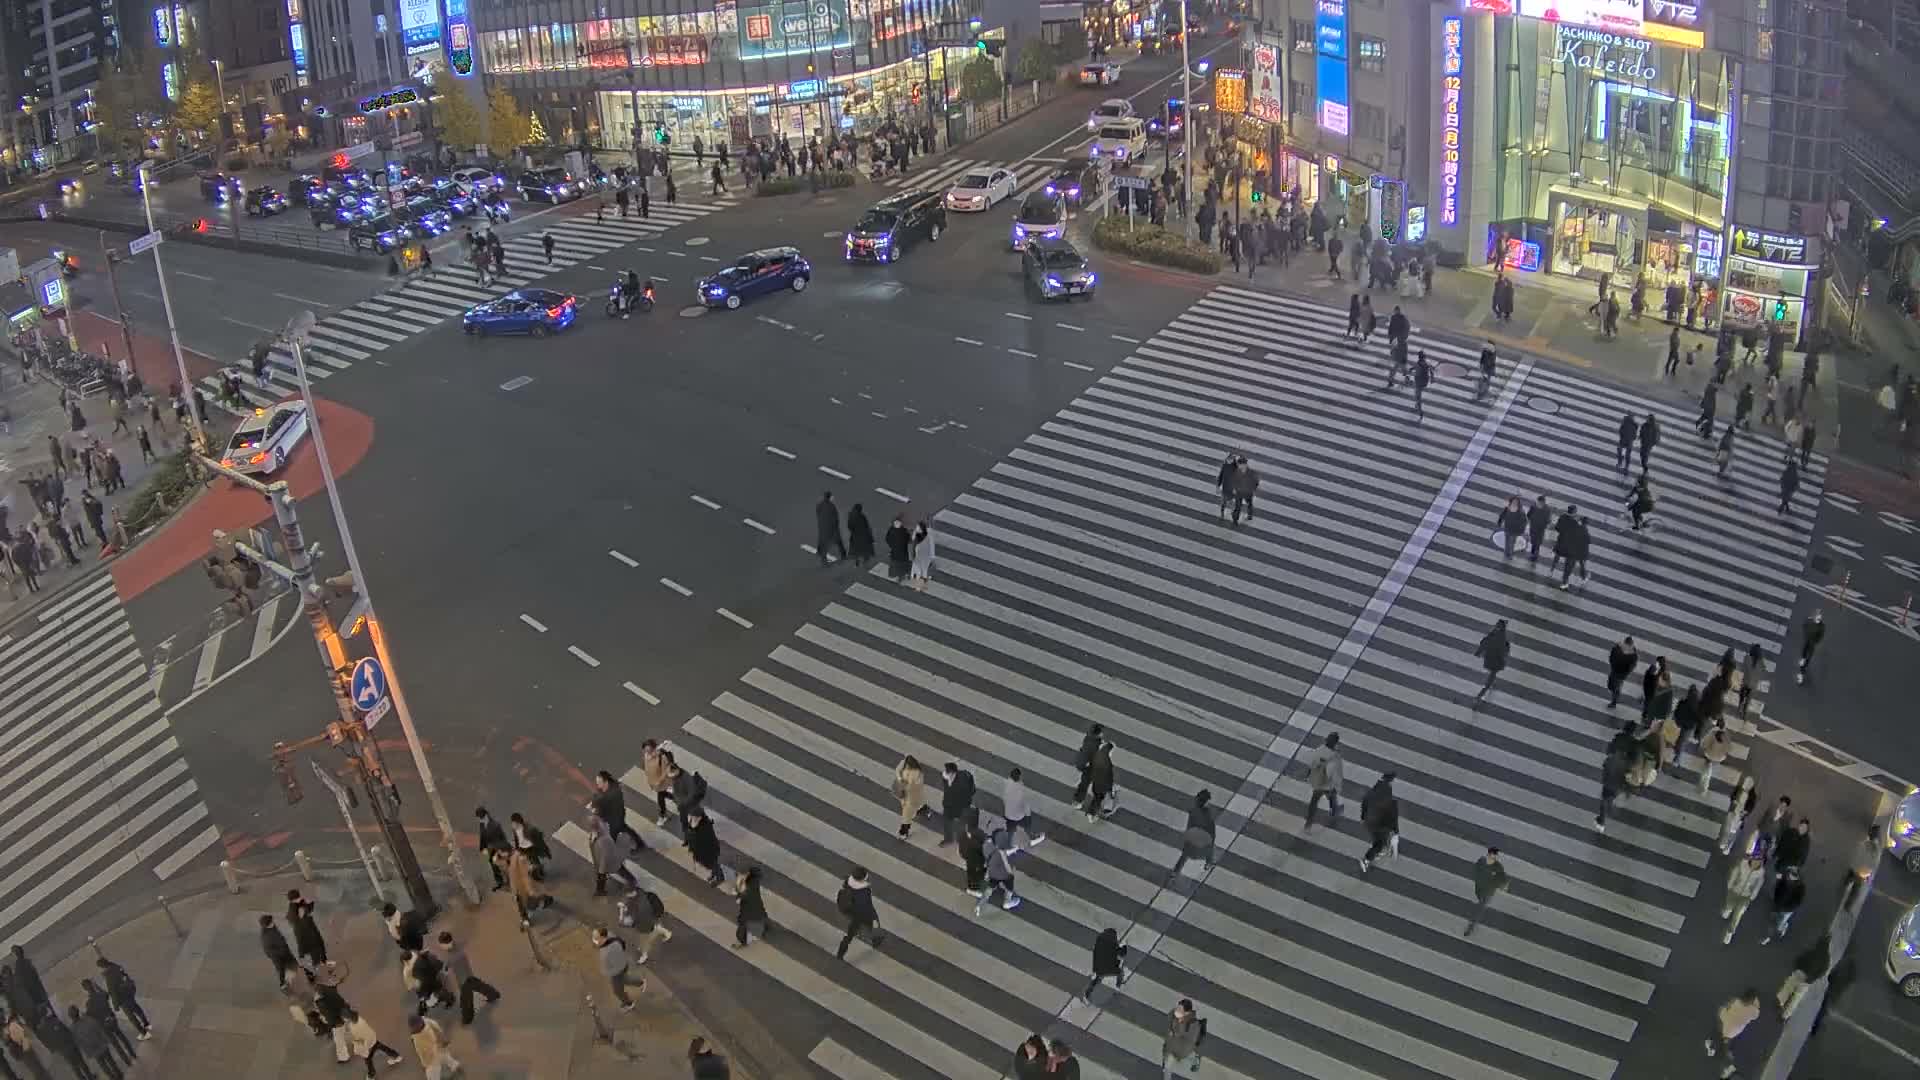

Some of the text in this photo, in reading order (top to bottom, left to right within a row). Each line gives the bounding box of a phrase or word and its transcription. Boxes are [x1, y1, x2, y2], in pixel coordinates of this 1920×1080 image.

[1556, 26, 1653, 53] PACHINKO & SLOT
[1551, 38, 1657, 80] Kaleido
